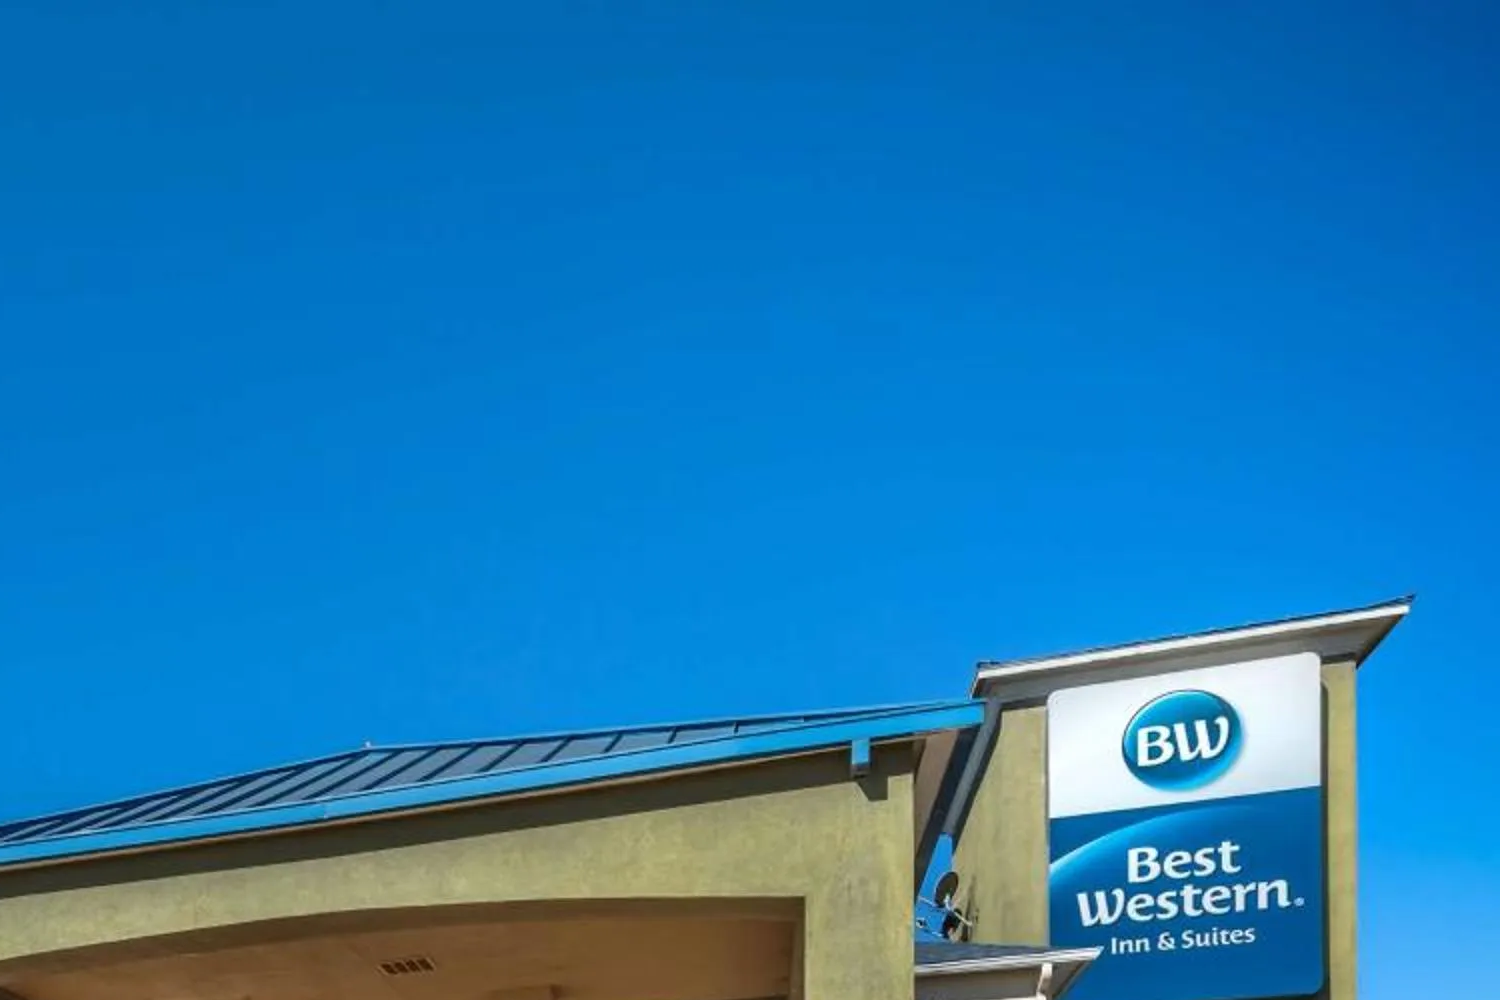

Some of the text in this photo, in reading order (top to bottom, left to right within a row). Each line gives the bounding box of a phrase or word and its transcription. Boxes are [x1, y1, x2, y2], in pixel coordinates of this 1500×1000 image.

[1136, 715, 1230, 767] BW
[1126, 840, 1242, 884] Best
[1076, 879, 1292, 927] Western
[1110, 926, 1256, 955] Inn & Suites
